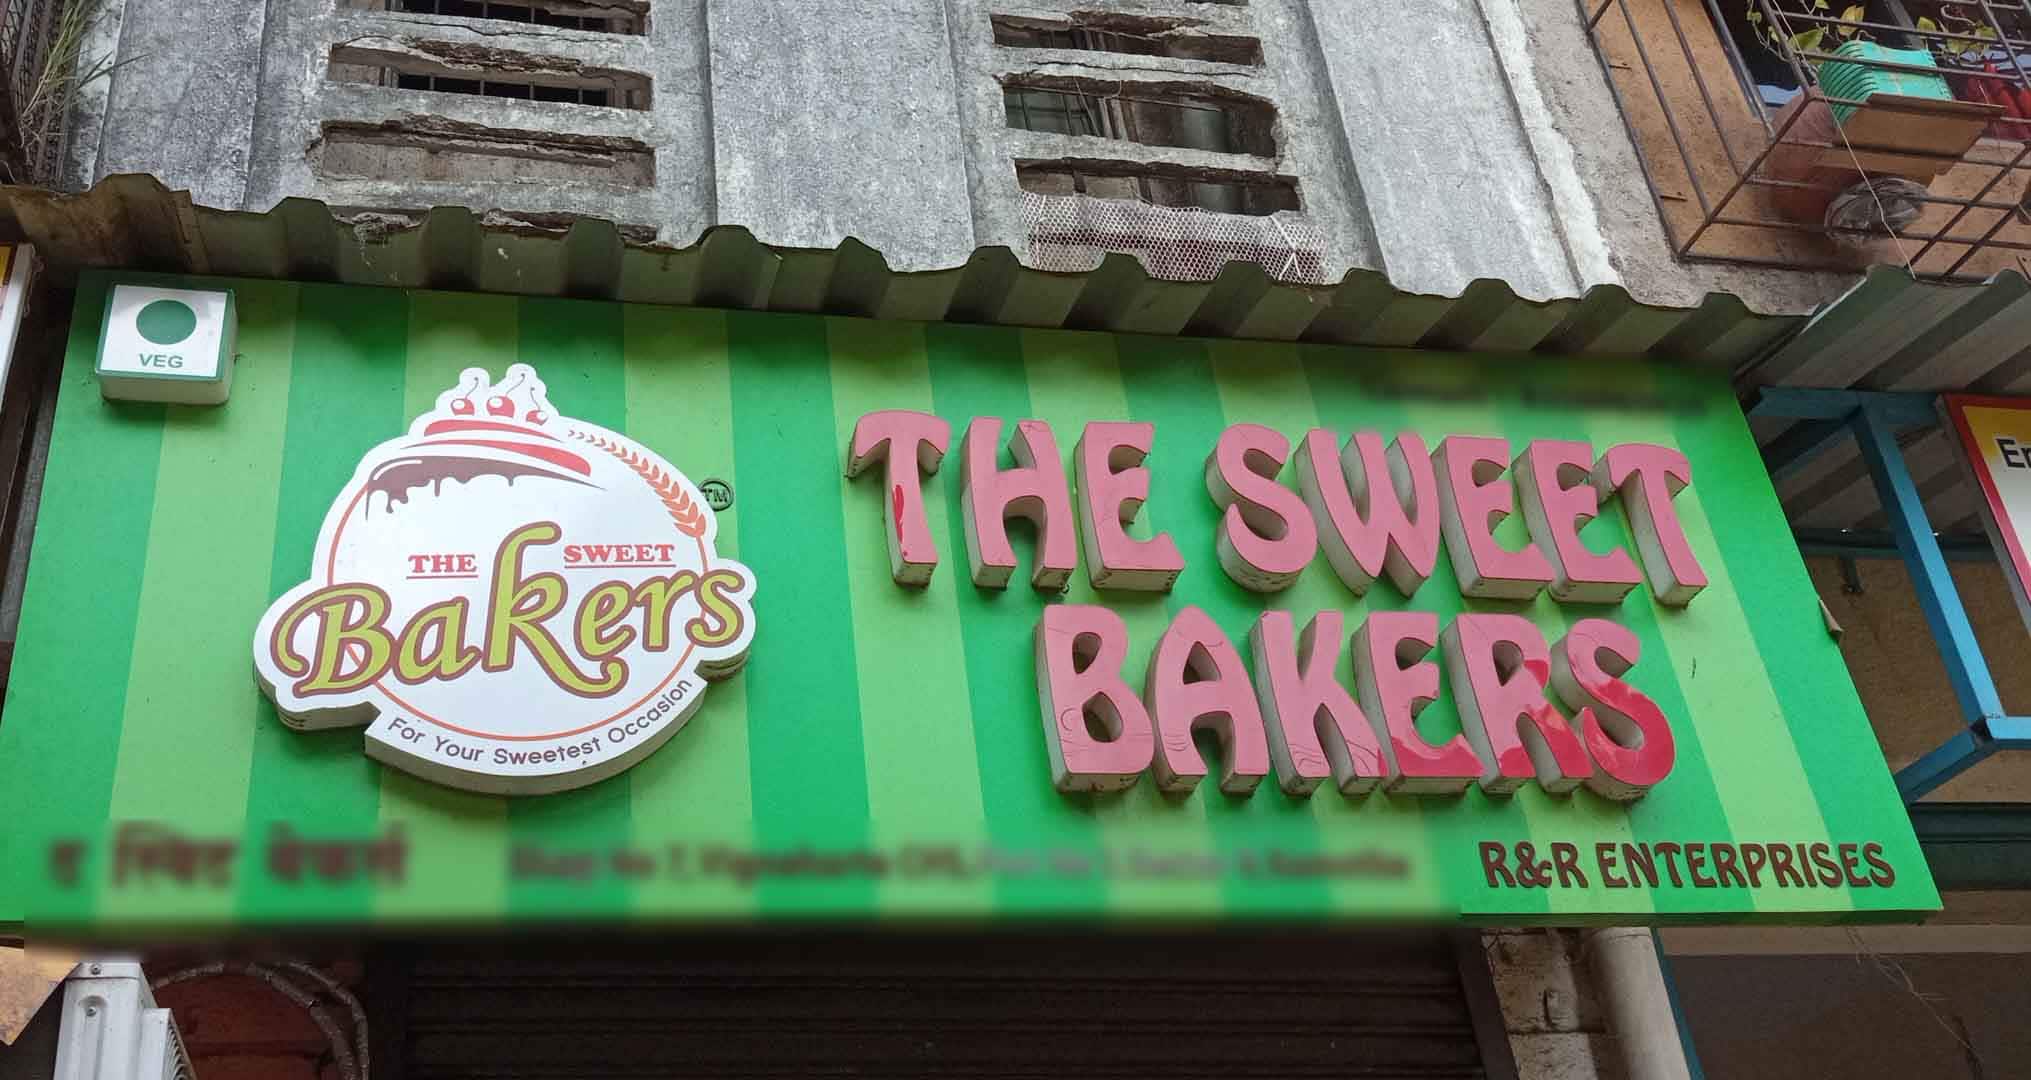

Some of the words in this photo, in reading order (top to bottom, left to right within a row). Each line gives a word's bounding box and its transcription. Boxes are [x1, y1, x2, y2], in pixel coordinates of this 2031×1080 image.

[139, 354, 183, 368] VEG
[847, 410, 1184, 589] THE
[1206, 423, 1707, 606] SWEET
[409, 555, 477, 574] THE
[564, 543, 675, 563] SWEET
[272, 522, 745, 698] Bakers
[387, 717, 425, 744] For
[434, 735, 484, 762] Your
[493, 736, 601, 765] Sweetest
[607, 677, 693, 743] Occasion
[1034, 604, 1675, 797] BAKERS
[1478, 841, 1589, 889] R&R
[1596, 842, 1896, 889] ENTERPRISES
